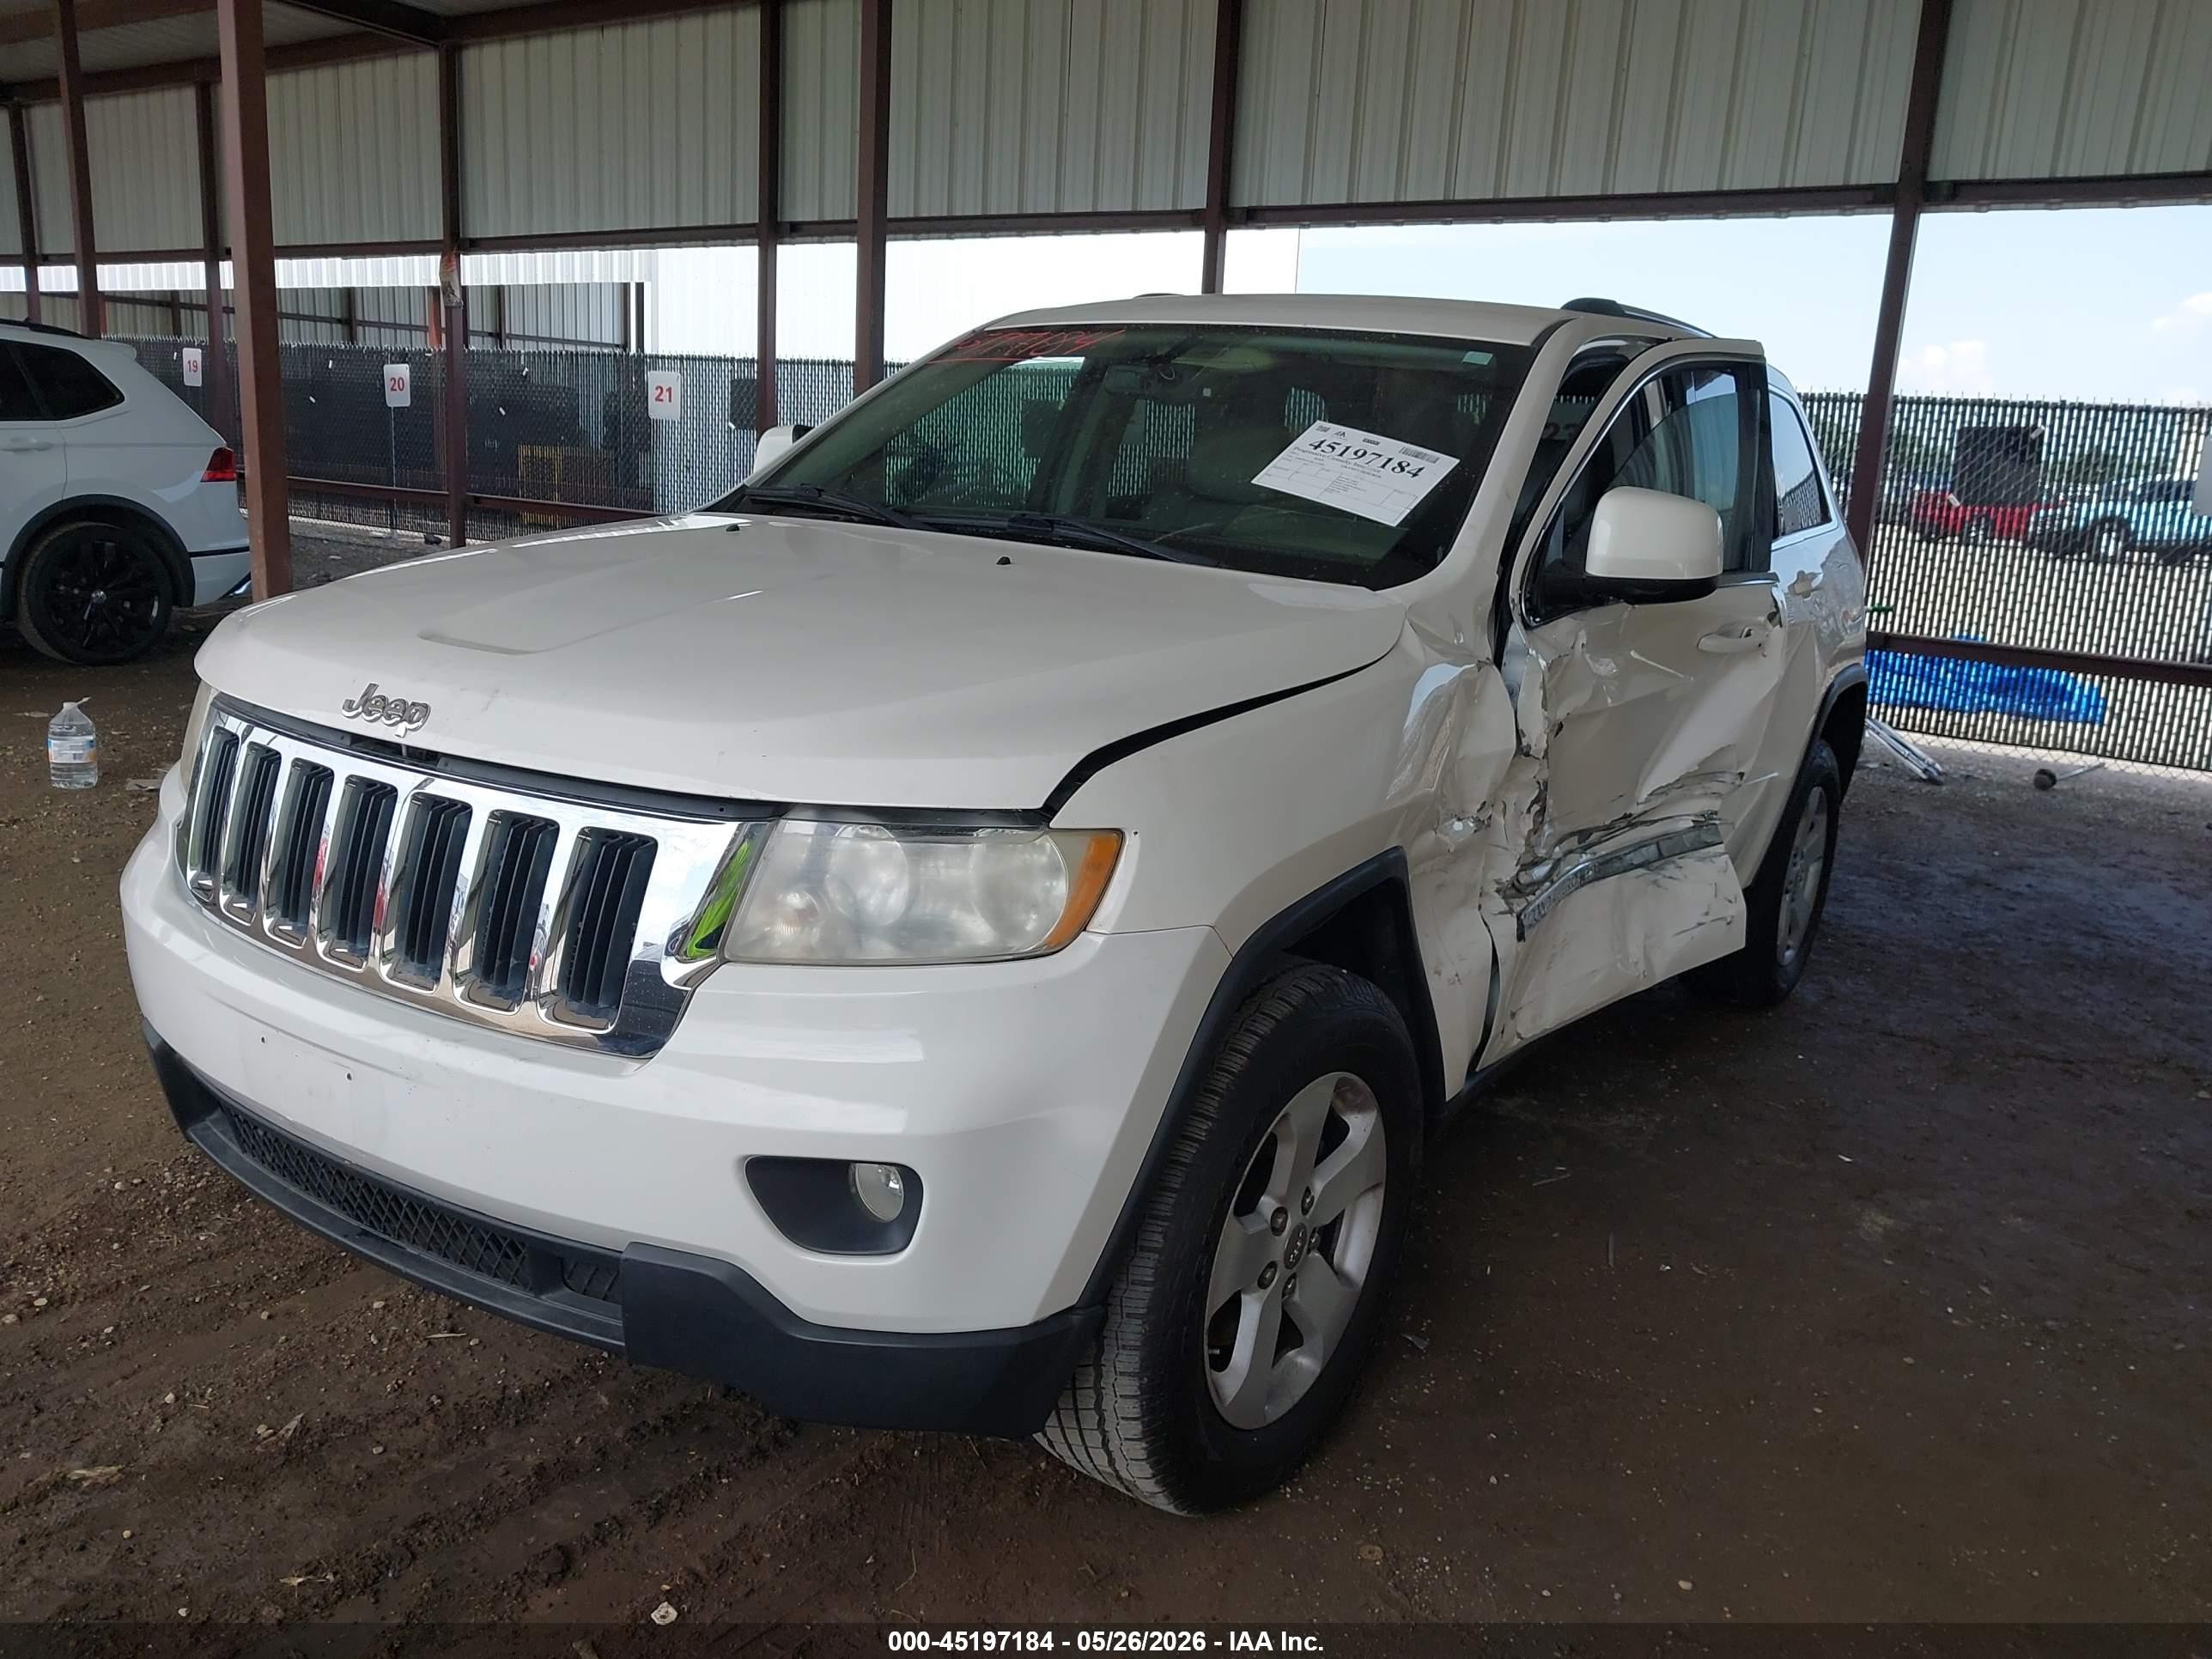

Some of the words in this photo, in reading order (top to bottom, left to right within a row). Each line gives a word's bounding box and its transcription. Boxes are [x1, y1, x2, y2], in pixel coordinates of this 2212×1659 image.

[187, 359, 198, 373] 19
[390, 377, 405, 392] 20
[654, 385, 672, 403] 21
[1308, 439, 1425, 478] 45197184
[342, 682, 431, 738] Jeep
